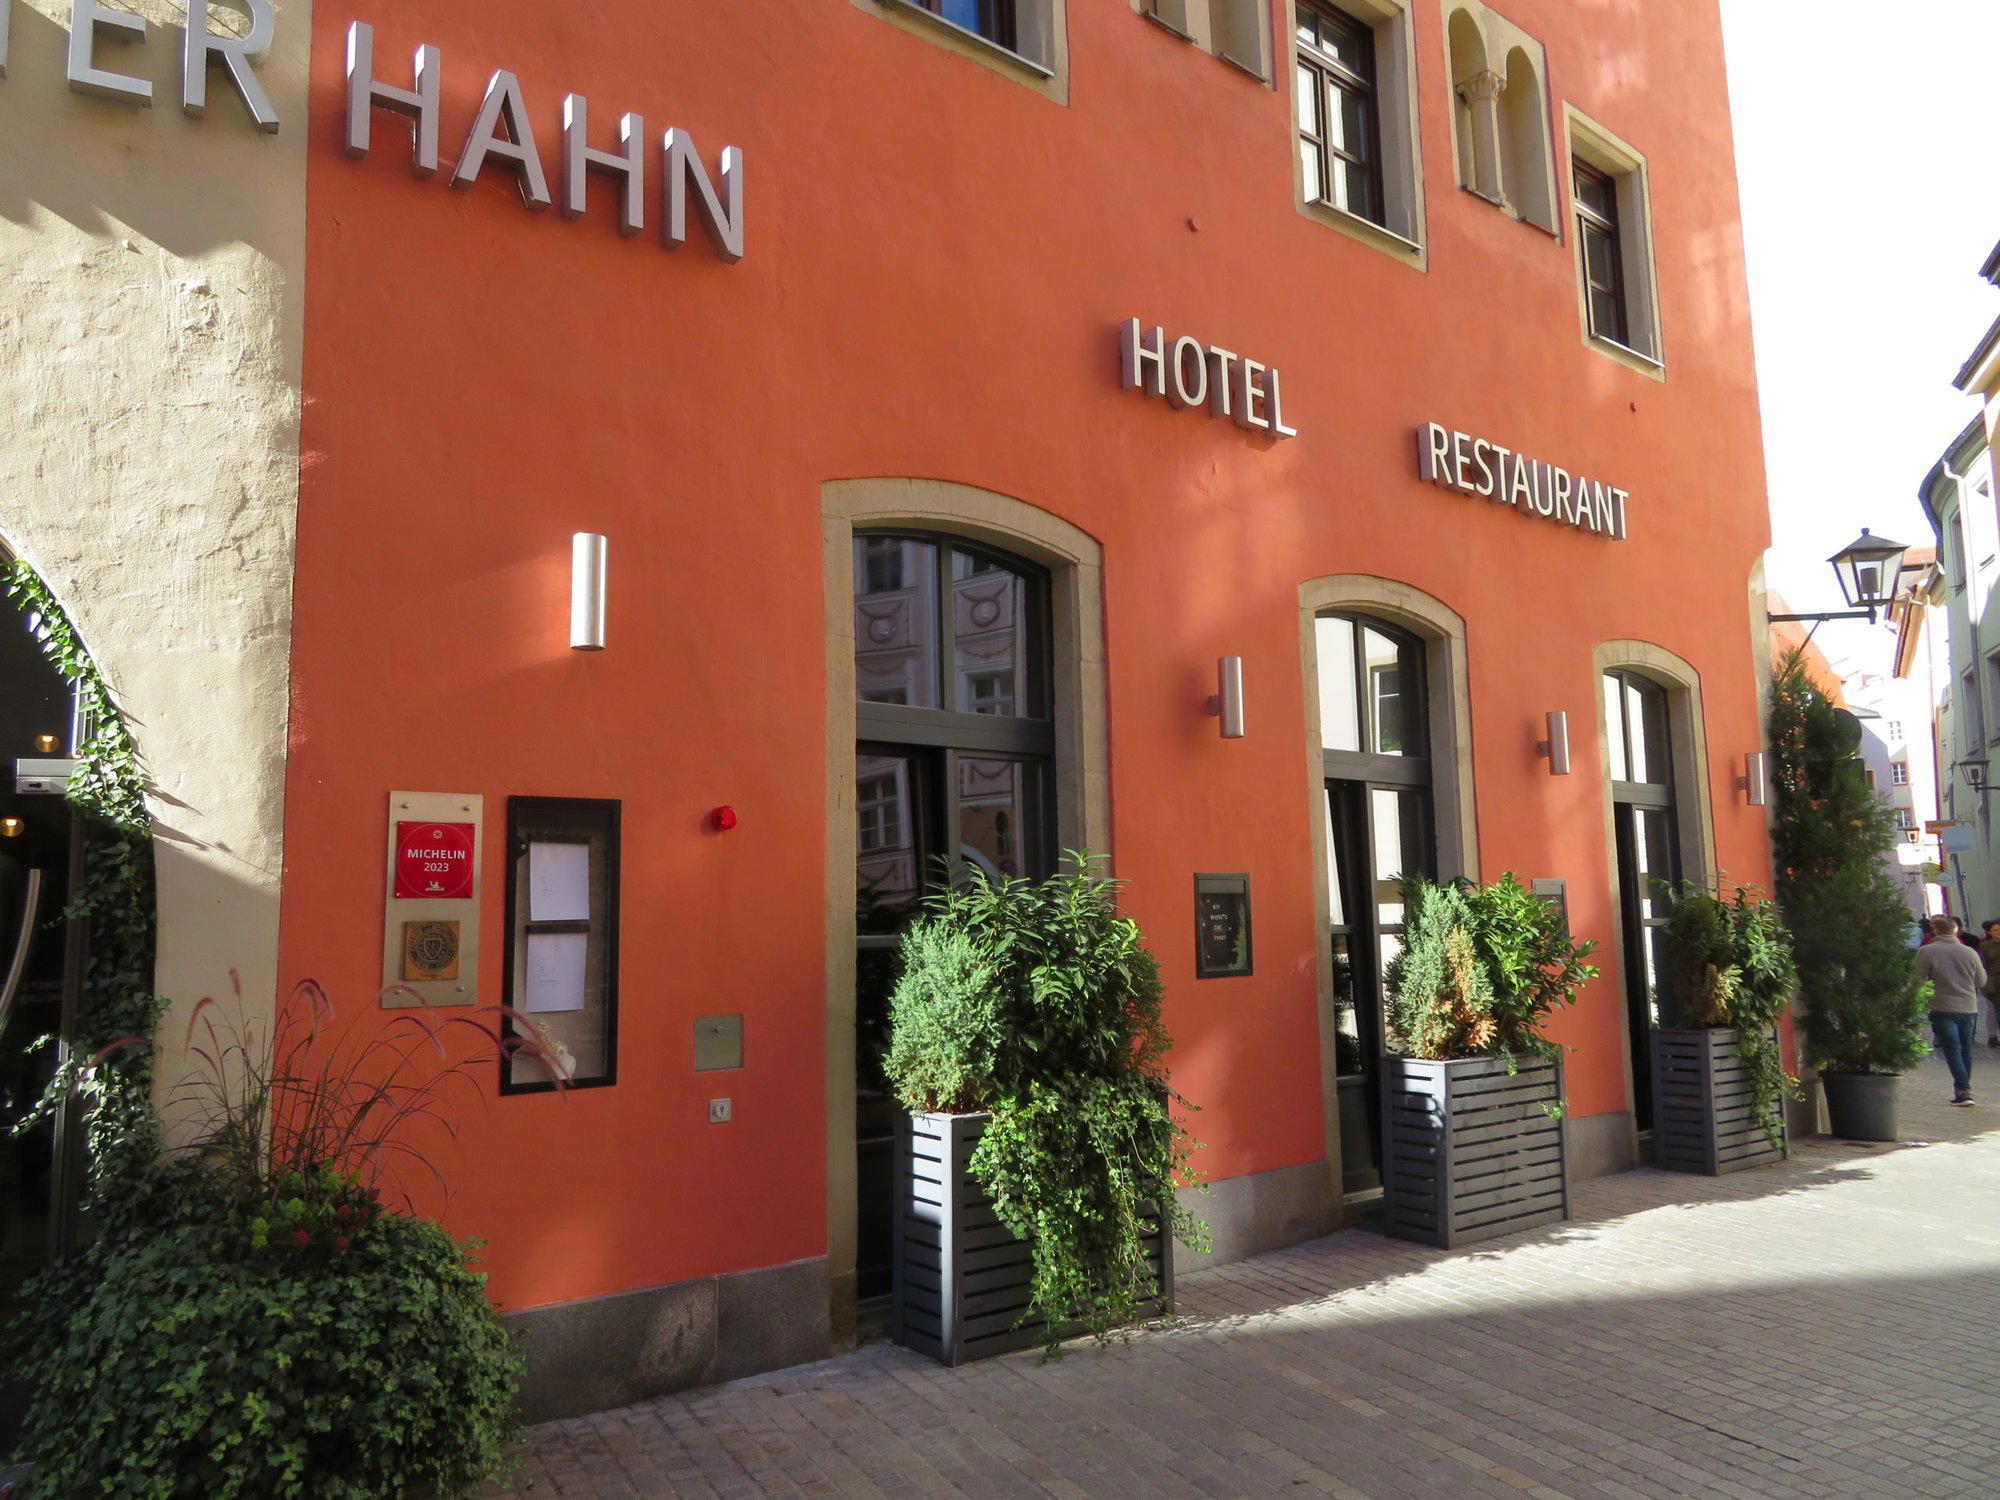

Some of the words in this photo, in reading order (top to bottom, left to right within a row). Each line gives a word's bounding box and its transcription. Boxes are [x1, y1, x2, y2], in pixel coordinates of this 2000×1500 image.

[0, 0, 280, 134] ER
[345, 20, 744, 263] HAHN
[1121, 317, 1297, 439] HOTEL
[1418, 421, 1629, 539] RESTAURANT
[407, 849, 466, 859] MICHELIN
[424, 862, 449, 872] 2023
